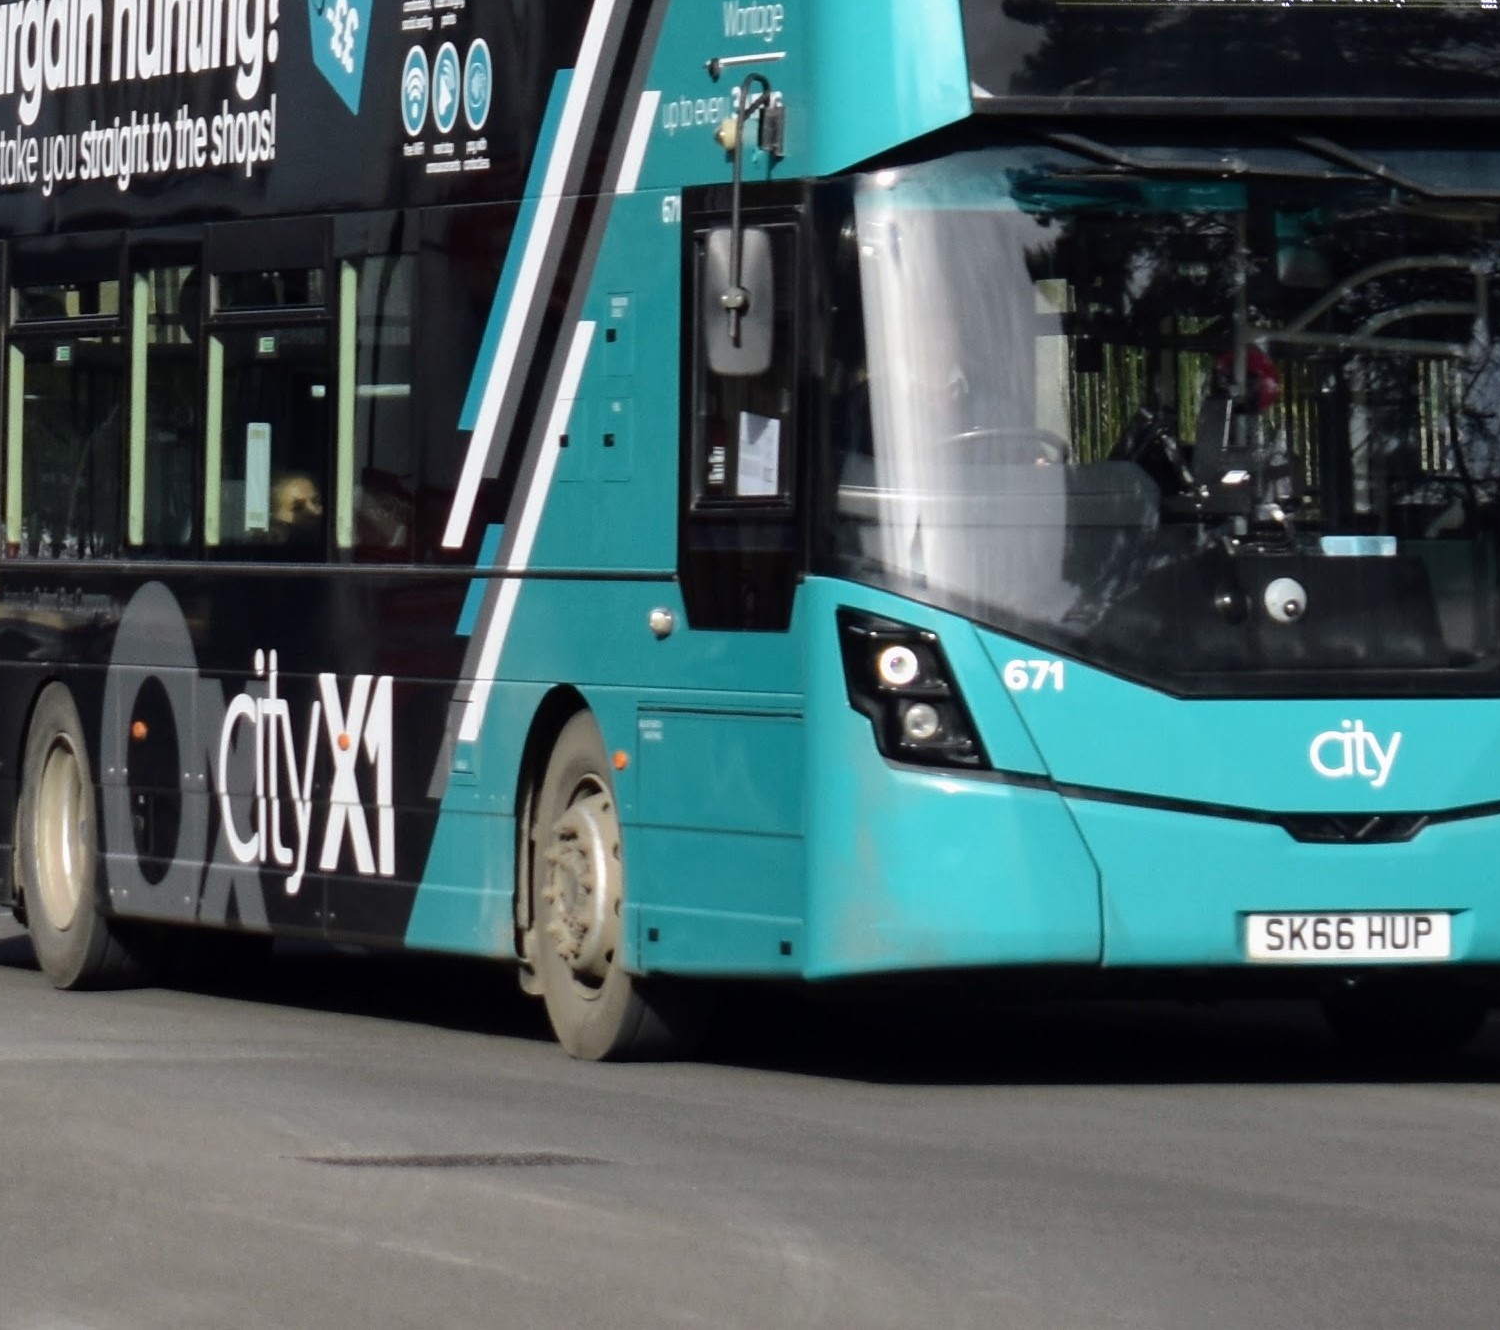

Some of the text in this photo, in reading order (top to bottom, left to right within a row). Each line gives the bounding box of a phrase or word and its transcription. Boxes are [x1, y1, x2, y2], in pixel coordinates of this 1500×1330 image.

[722, 0, 785, 43] Wantage
[0, 126, 38, 185] take
[43, 131, 77, 198] you
[80, 109, 150, 192] straight
[152, 111, 172, 174] to
[174, 103, 207, 170] the
[210, 93, 278, 178] shops!
[1003, 659, 1065, 691] 671
[218, 648, 395, 897] city X1
[1308, 719, 1403, 788] city
[1265, 916, 1433, 952] SK66 HUP
